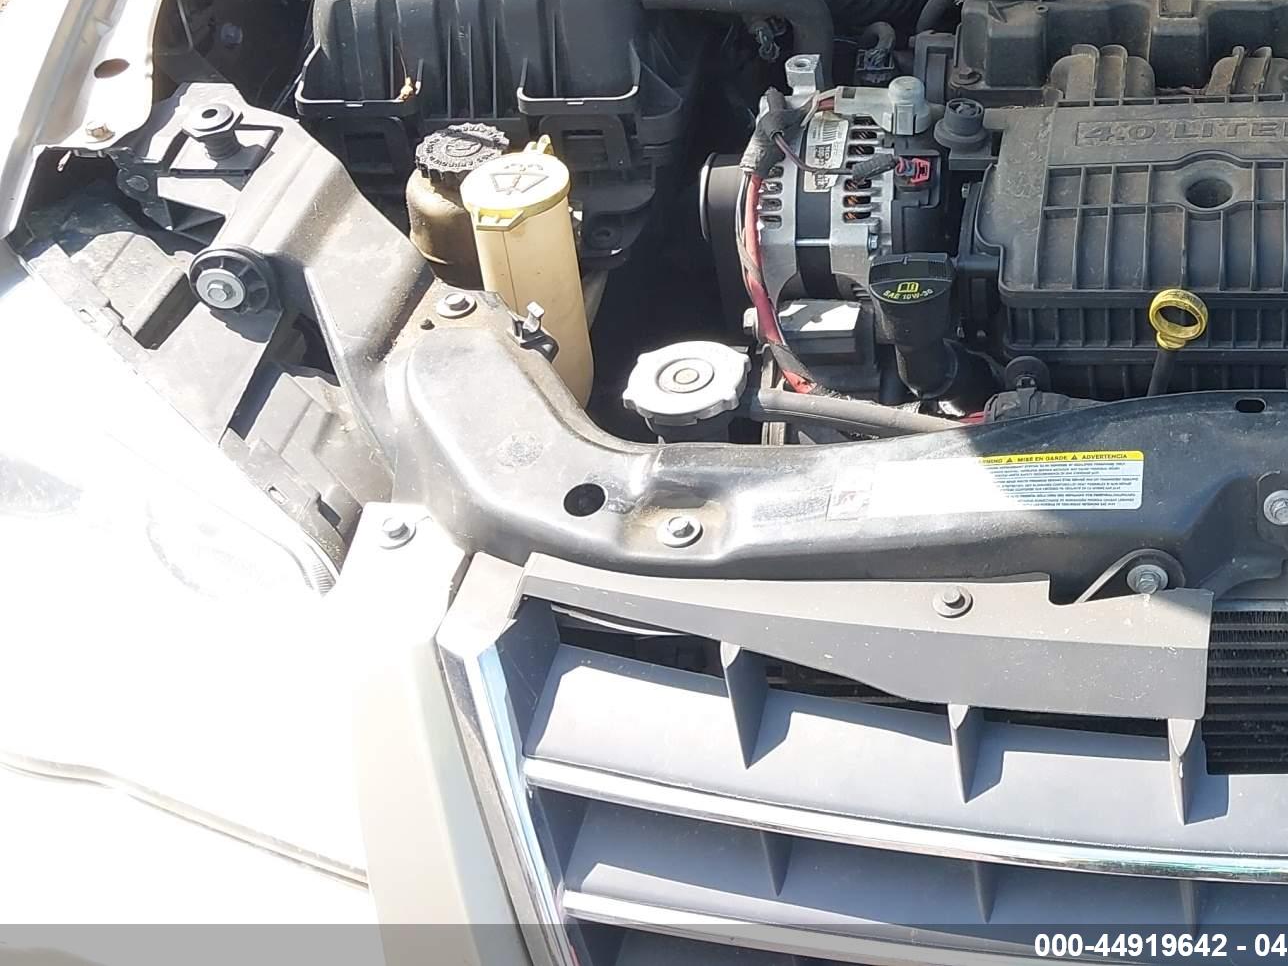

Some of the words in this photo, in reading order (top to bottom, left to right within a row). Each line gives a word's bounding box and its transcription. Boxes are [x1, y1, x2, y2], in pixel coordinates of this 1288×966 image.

[1084, 125, 1155, 141] 4.0
[883, 289, 900, 300] SAE
[1045, 454, 1068, 462] GARDE
[1082, 453, 1128, 461] ADVERTENCIA
